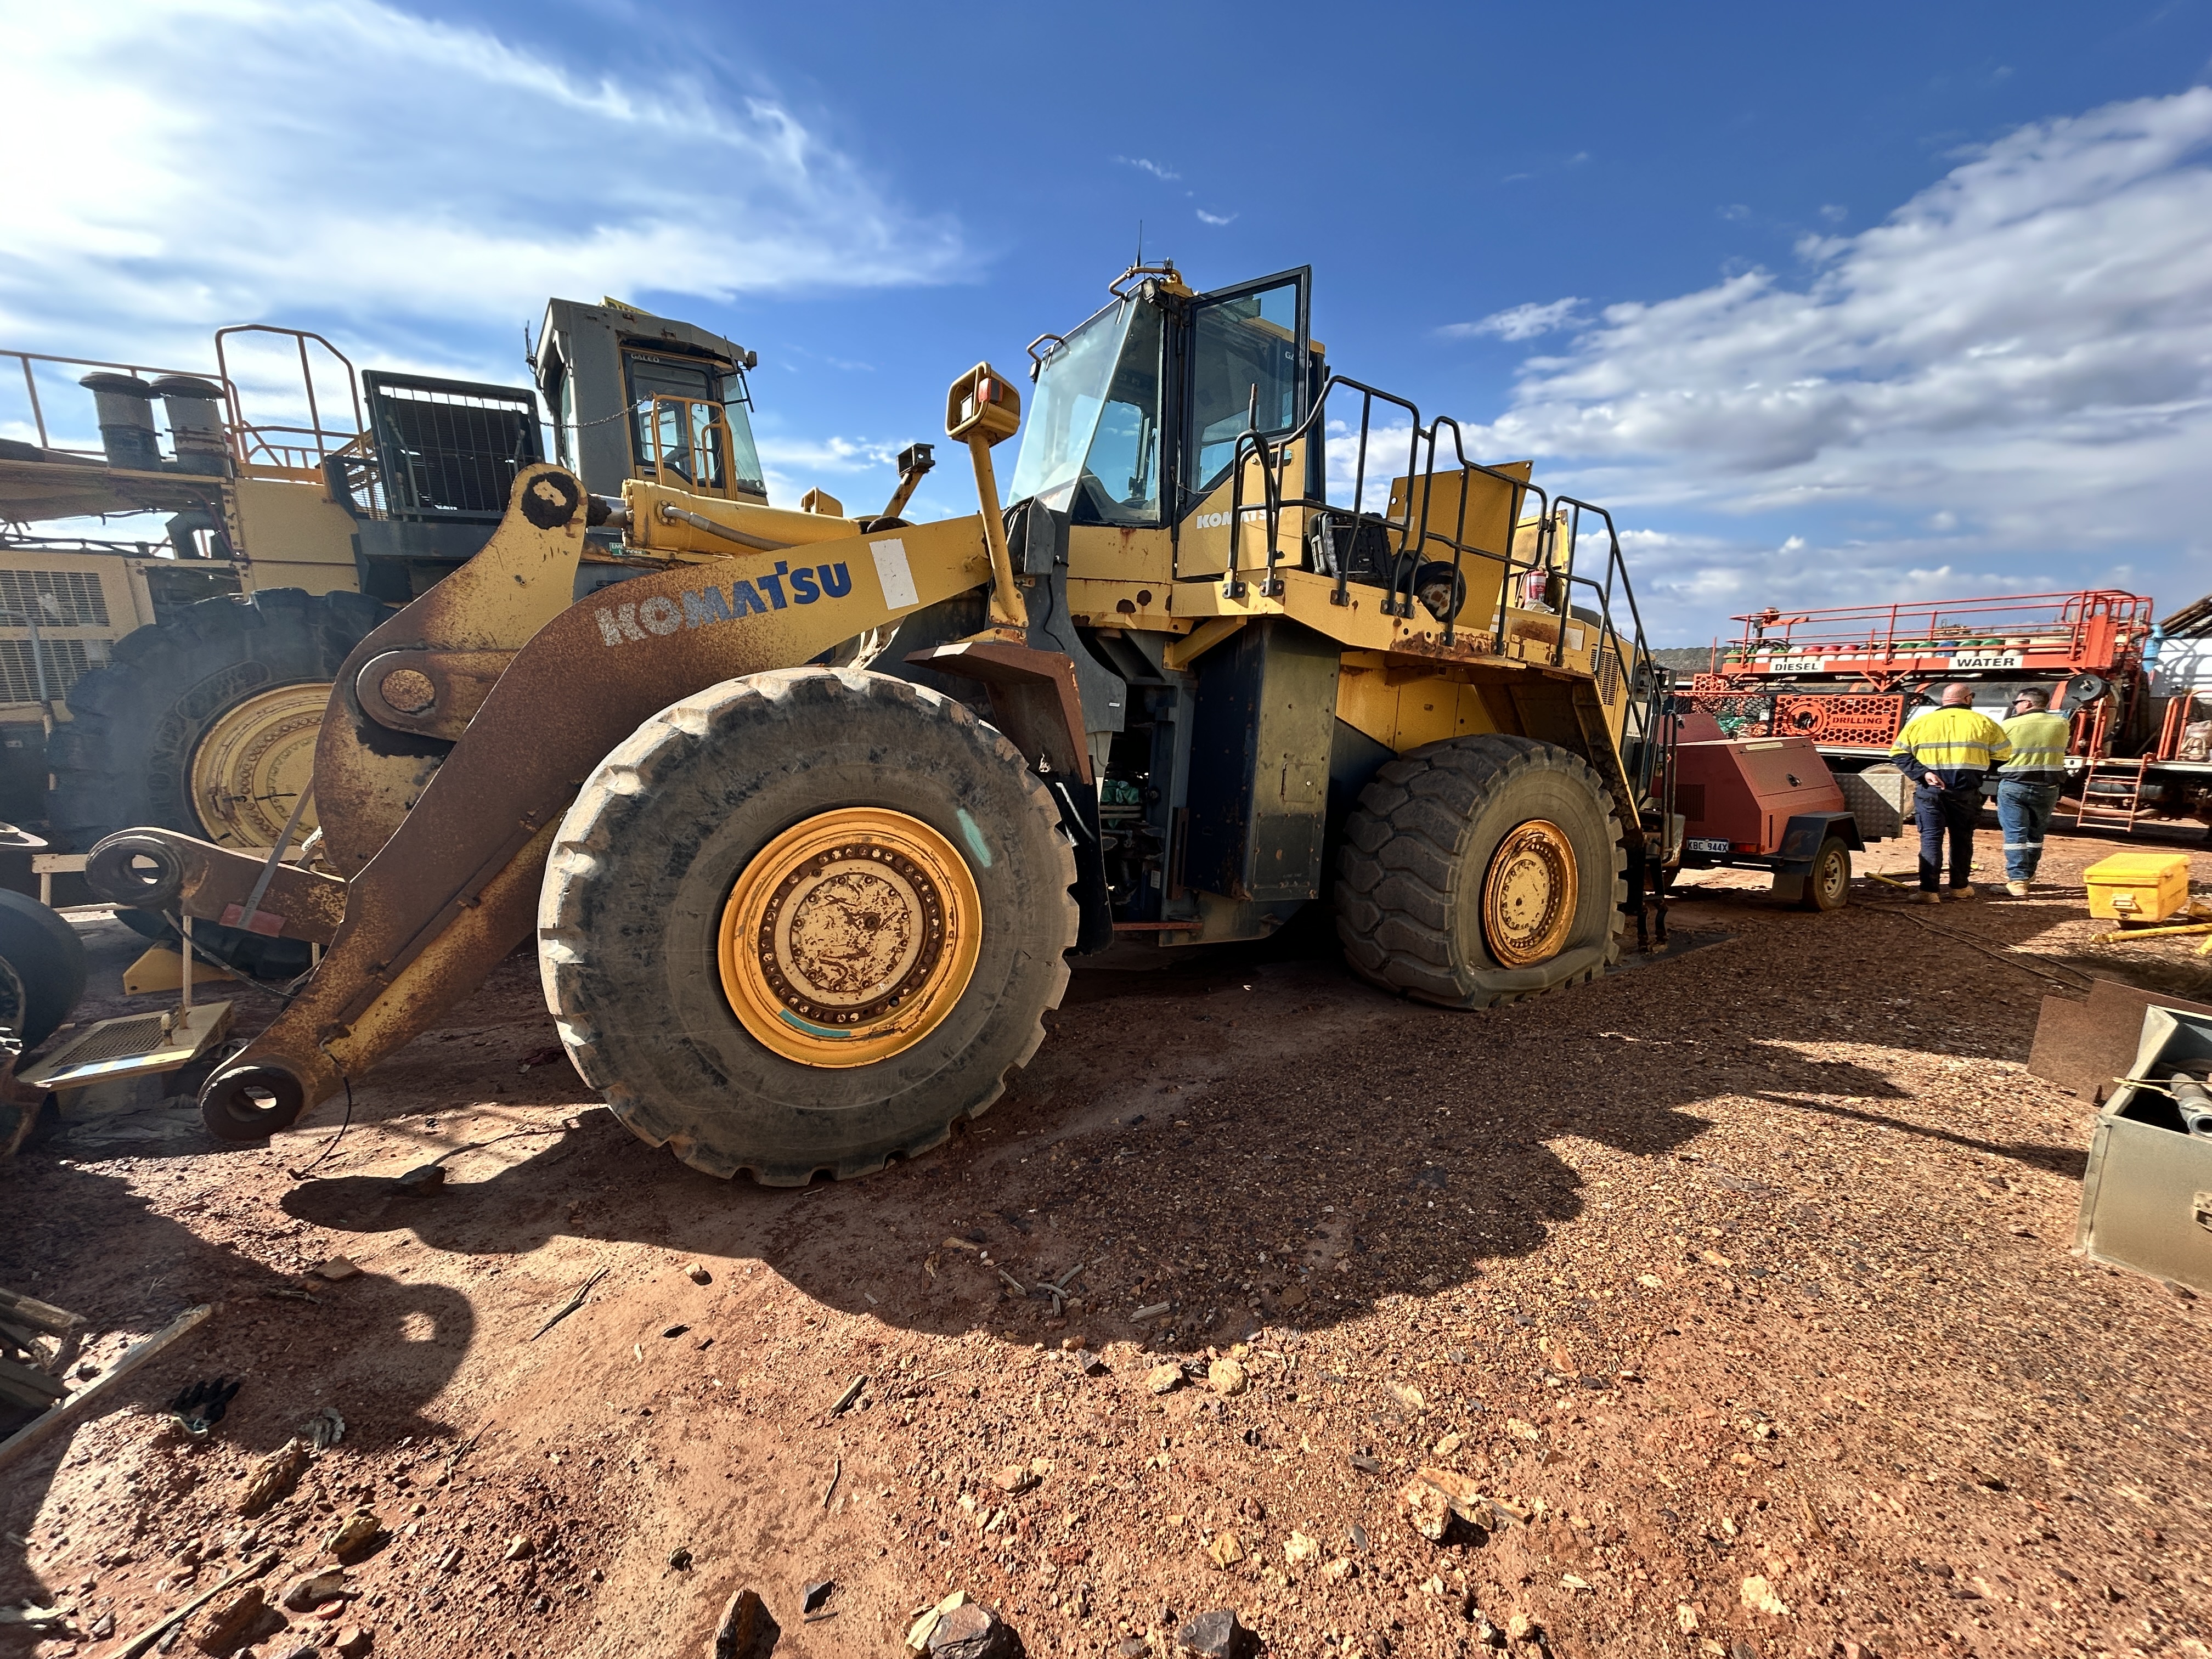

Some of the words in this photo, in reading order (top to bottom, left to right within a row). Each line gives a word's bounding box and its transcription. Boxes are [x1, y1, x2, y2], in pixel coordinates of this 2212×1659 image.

[594, 560, 853, 647] KOMATSU
[1775, 663, 1819, 671] DIESEL
[1957, 658, 2015, 667] WATER
[1689, 841, 1703, 850] KBC
[1707, 843, 1728, 851] 944X
